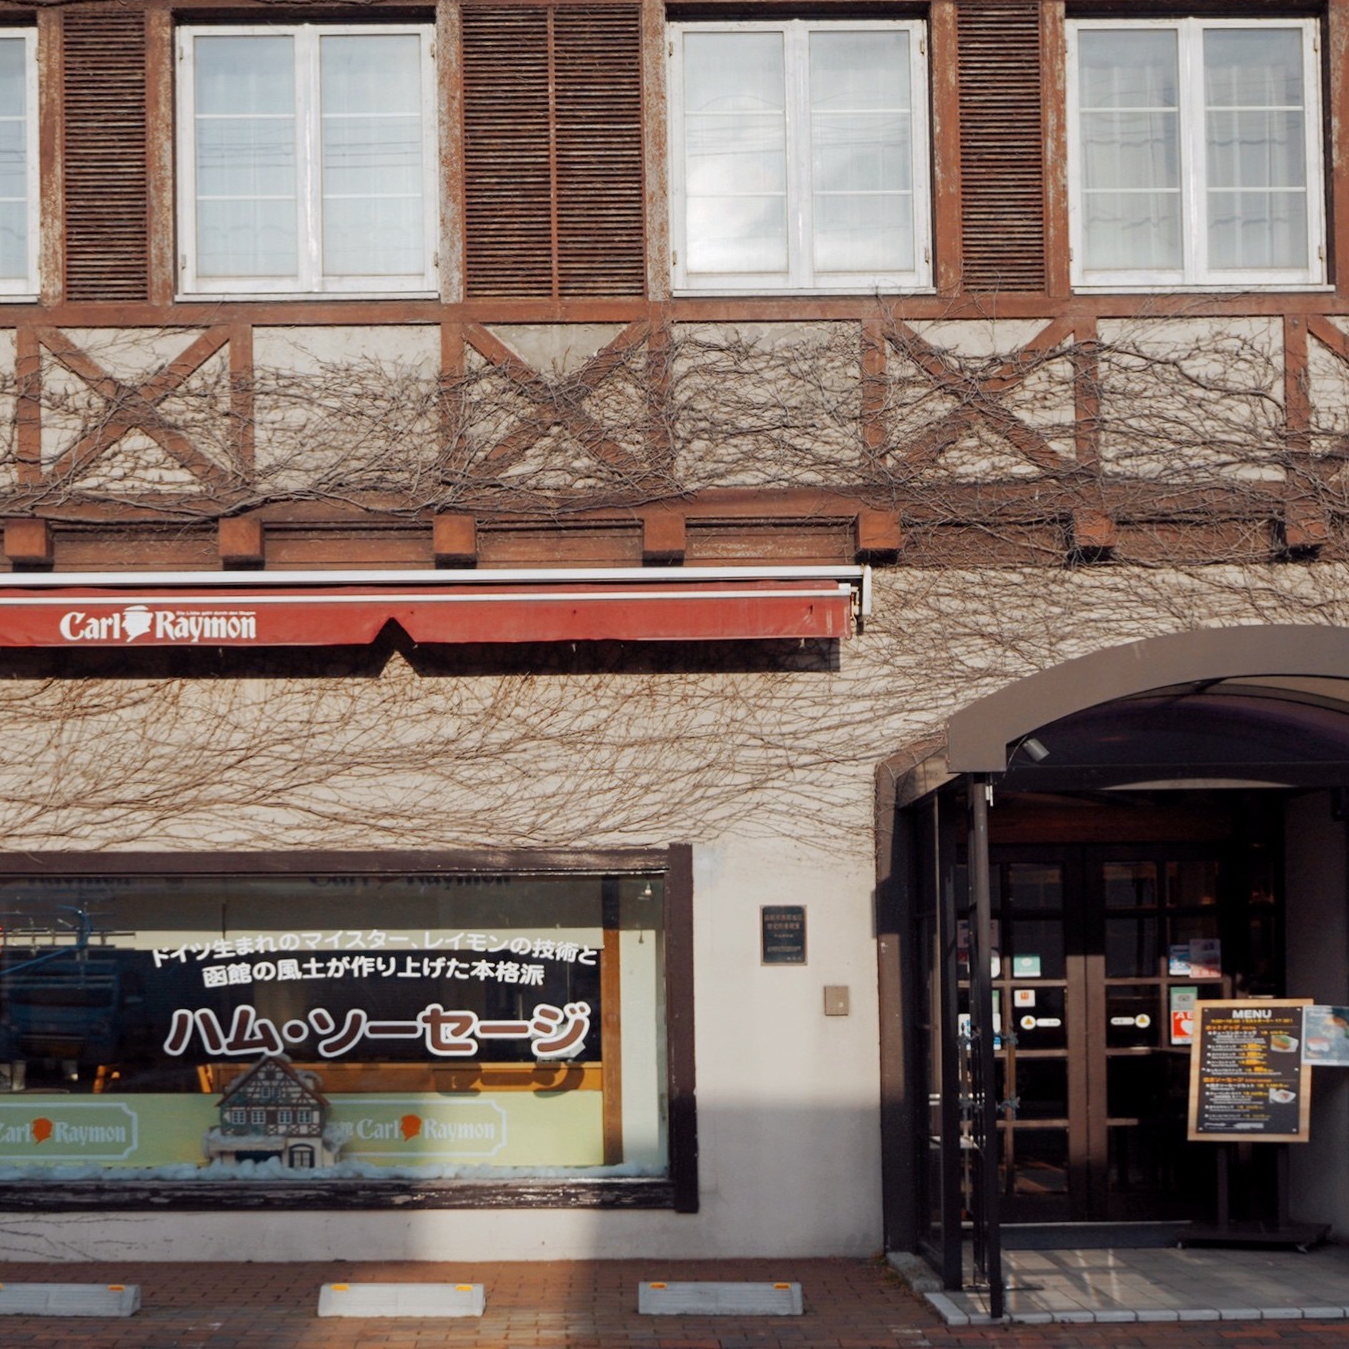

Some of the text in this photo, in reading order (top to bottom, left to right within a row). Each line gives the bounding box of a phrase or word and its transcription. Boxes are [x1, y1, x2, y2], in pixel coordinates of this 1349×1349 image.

[59, 611, 256, 642] Carl Raymon
[151, 929, 599, 968] ドイツ生まれのマイスター、レイモンの技術と
[202, 956, 545, 989] 函館の風土が作り上げた本格派
[163, 1000, 591, 1058] ハム・ソーセージ
[1232, 1009, 1272, 1019] MENU
[55, 1121, 126, 1146] Raymon
[357, 1118, 400, 1140] Carl
[423, 1117, 495, 1142] Raymon
